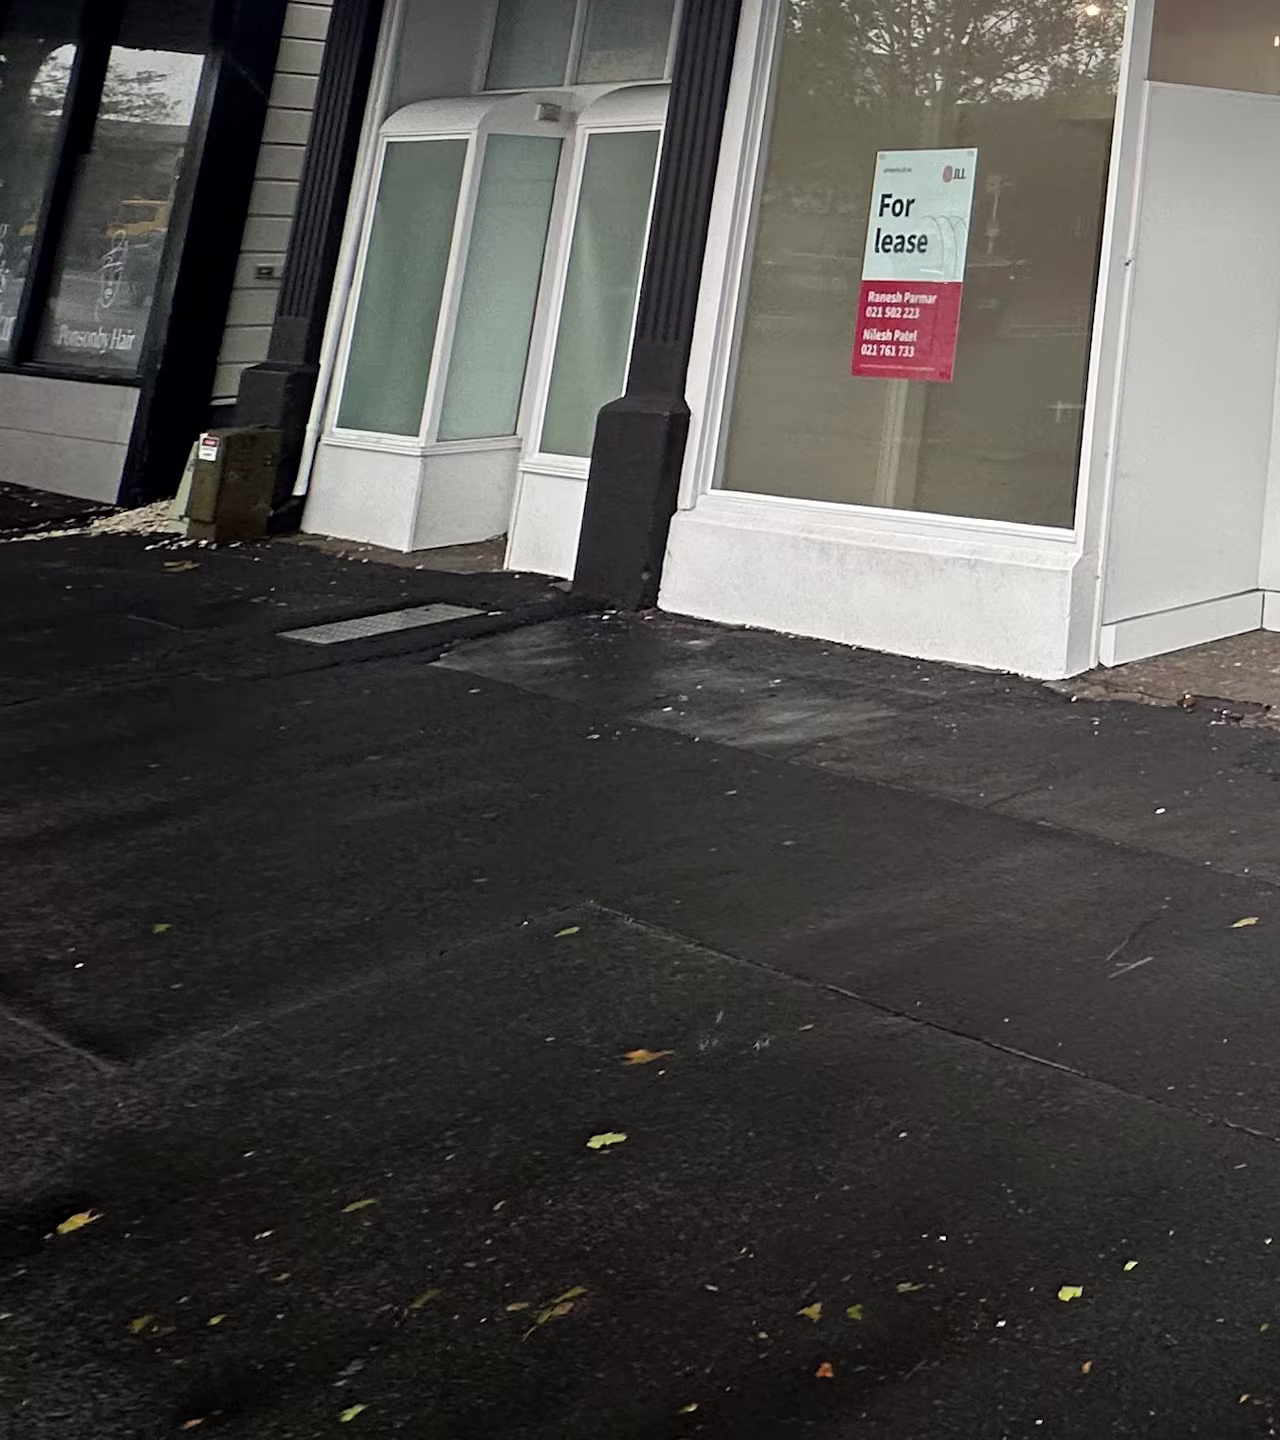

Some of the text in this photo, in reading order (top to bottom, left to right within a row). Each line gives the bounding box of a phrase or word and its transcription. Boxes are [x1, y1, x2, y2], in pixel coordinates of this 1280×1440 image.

[879, 193, 916, 218] For
[874, 227, 928, 254] lease
[865, 306, 883, 318] 021
[902, 306, 920, 319] 223
[862, 328, 918, 342] Nilesh Patel
[860, 343, 915, 358] 021 761 733
